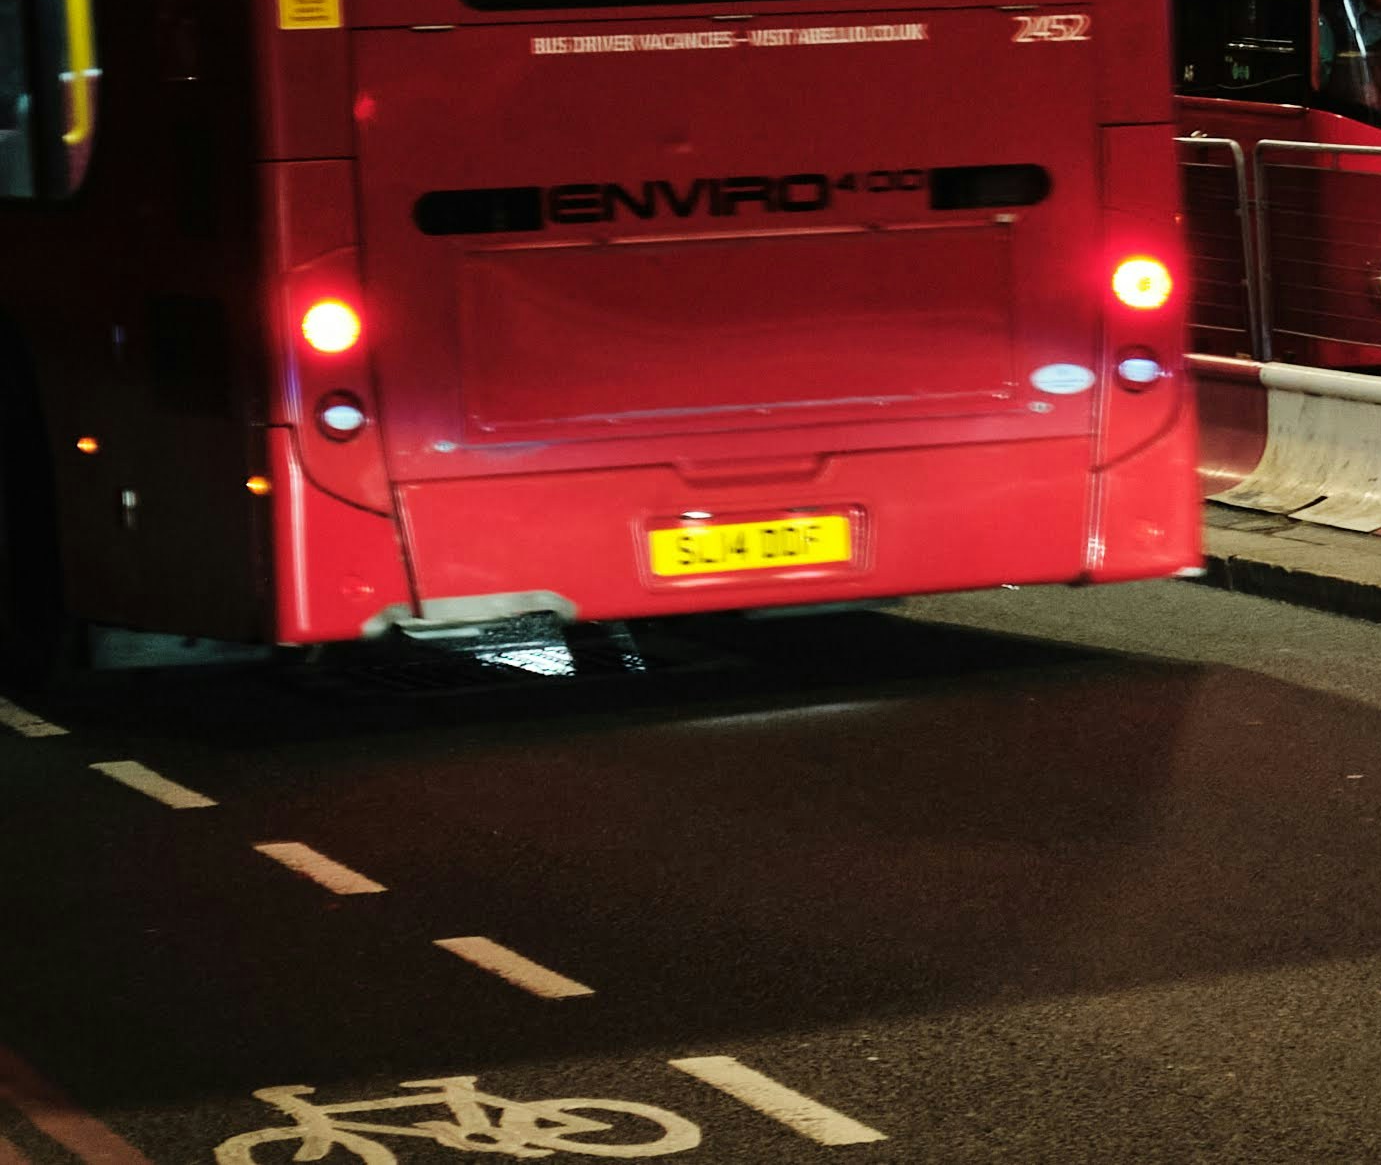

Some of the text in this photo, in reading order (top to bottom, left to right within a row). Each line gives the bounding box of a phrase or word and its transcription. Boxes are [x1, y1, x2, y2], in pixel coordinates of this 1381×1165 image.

[533, 37, 568, 55] BUS
[573, 35, 636, 53] DRIVER
[639, 31, 735, 51] VACANCIES
[747, 29, 793, 47] VISIT
[1011, 14, 1092, 43] 2452
